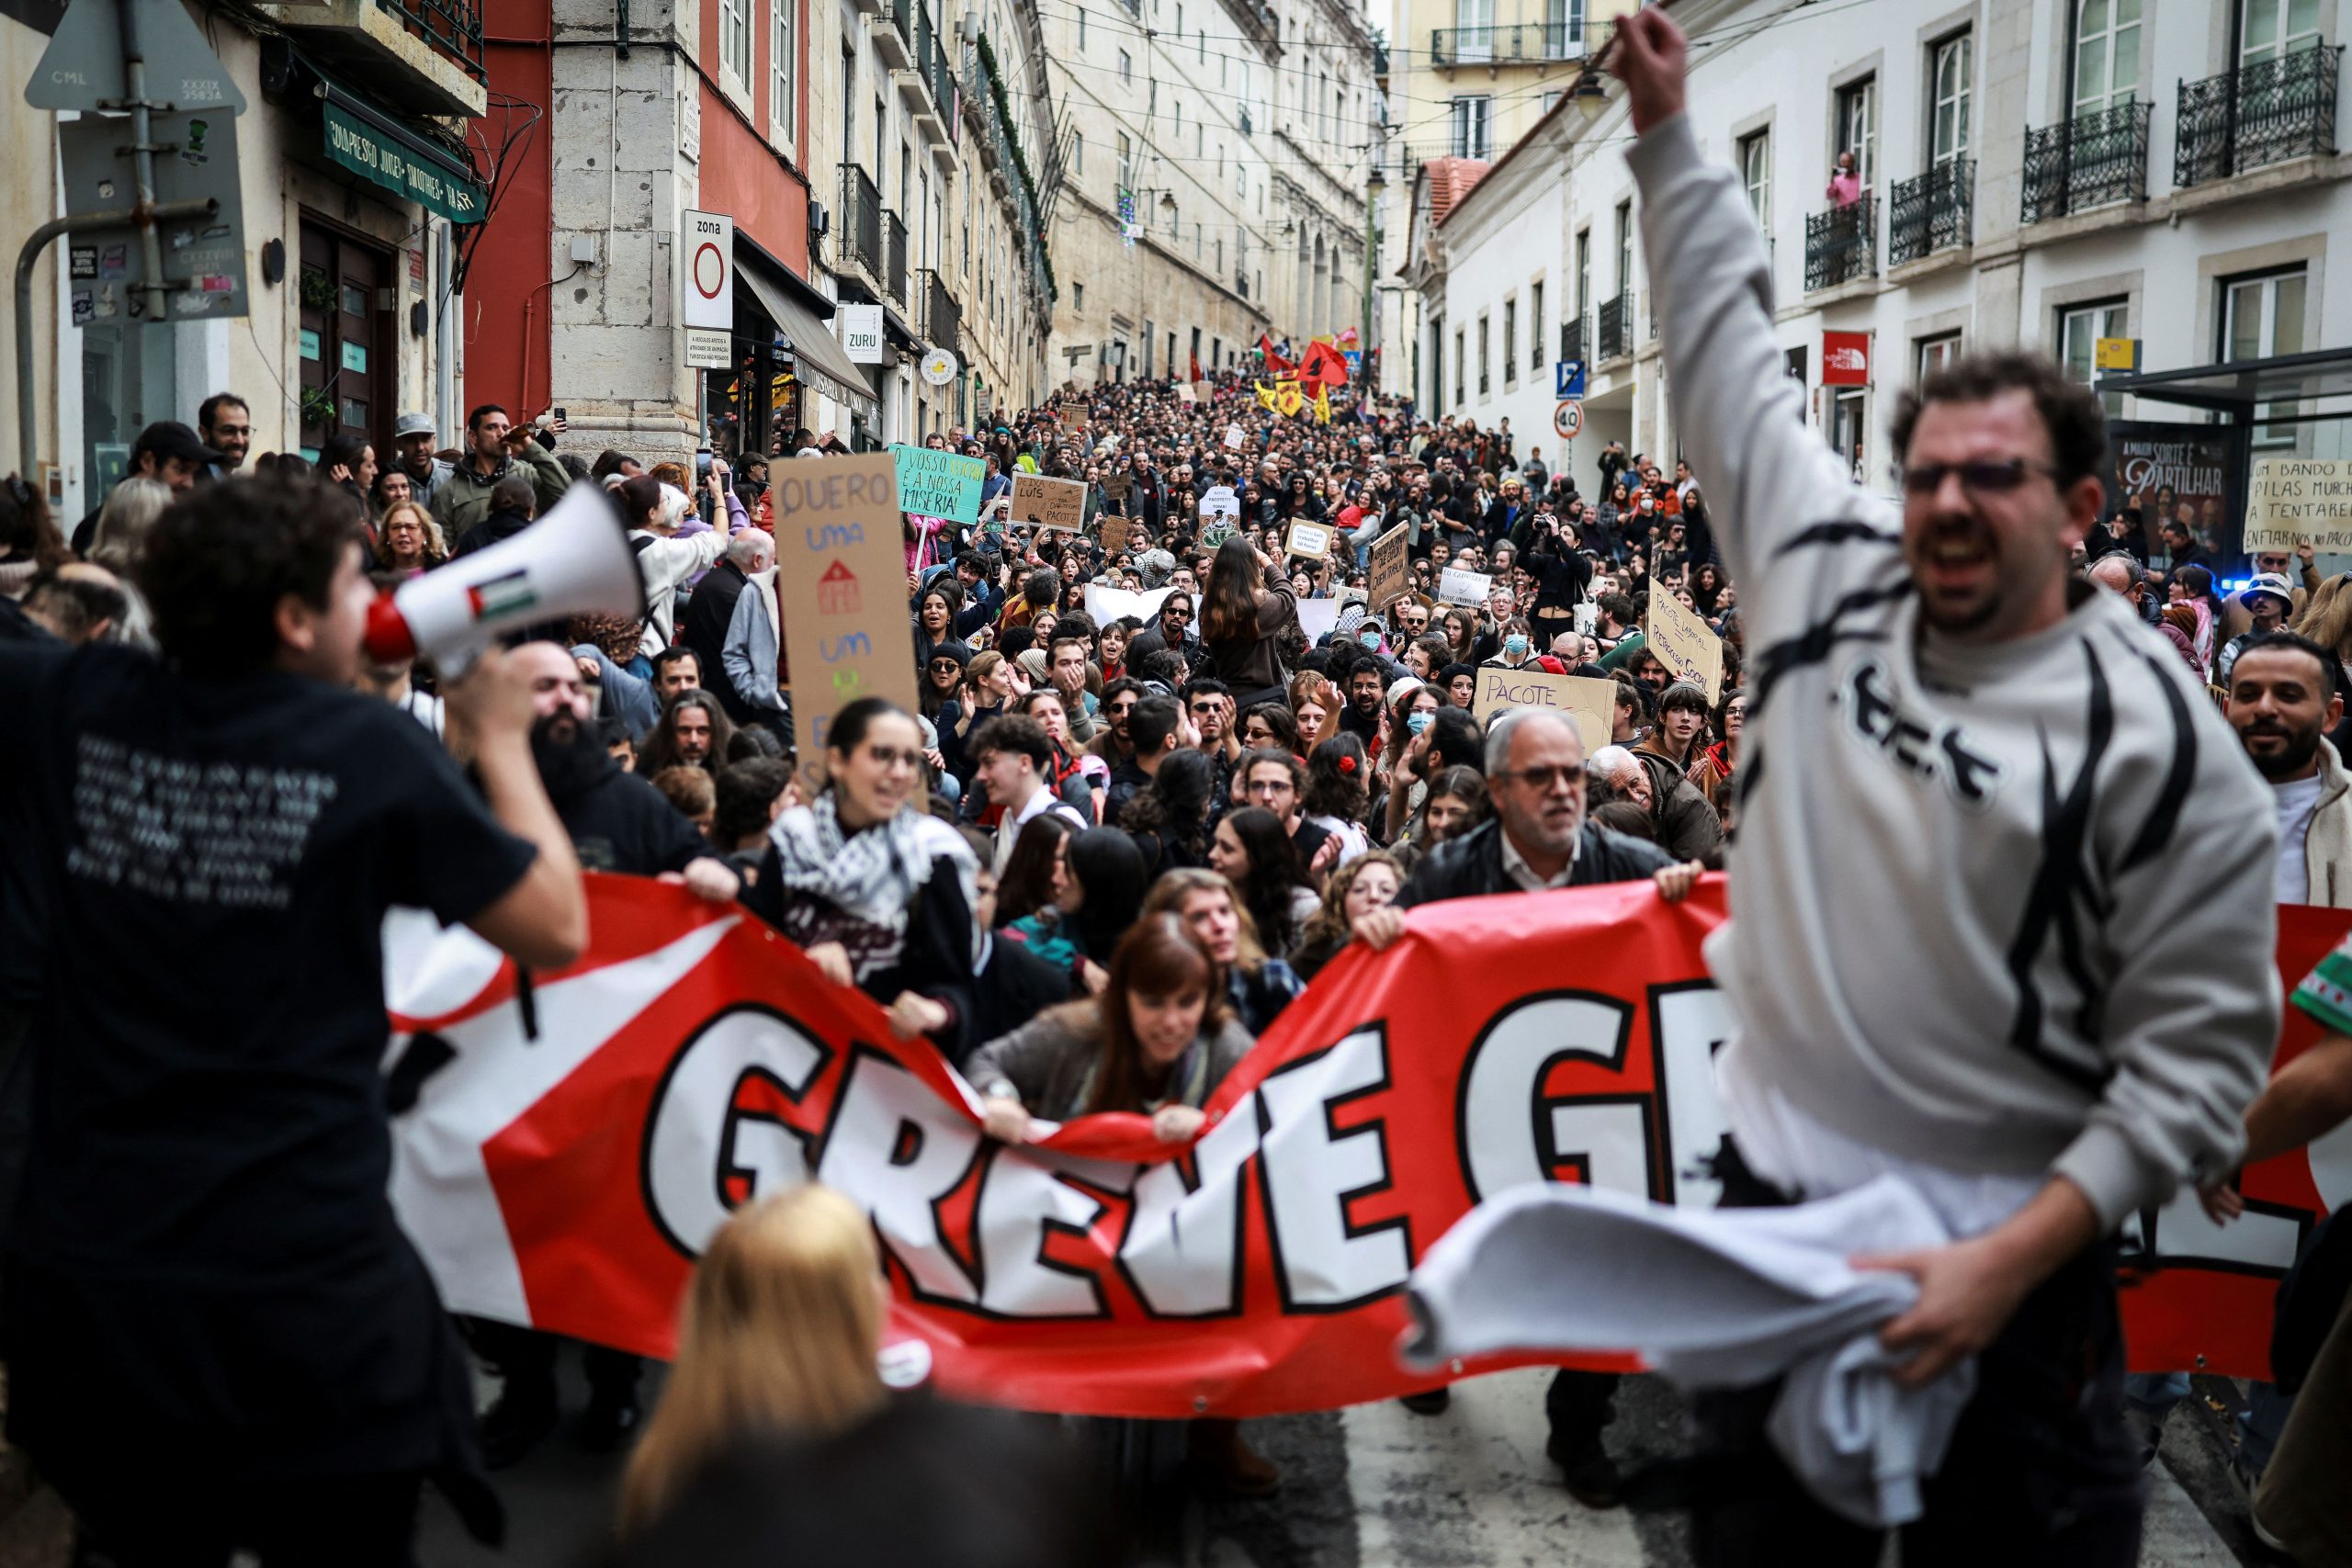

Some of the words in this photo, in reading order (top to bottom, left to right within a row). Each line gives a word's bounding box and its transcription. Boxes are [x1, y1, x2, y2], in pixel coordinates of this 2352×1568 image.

[51, 71, 87, 85] CML
[697, 220, 720, 235] zona
[849, 333, 876, 347] ZURU
[1559, 411, 1577, 426] 40
[894, 447, 901, 465] O
[910, 452, 947, 473] VOSSO
[2122, 442, 2129, 456] A
[2153, 443, 2186, 466] SORTE
[2187, 443, 2195, 467] É
[2125, 457, 2222, 495] PARTILHAR
[2256, 465, 2269, 478] UM
[2280, 463, 2335, 476] BANDO
[902, 468, 911, 487] É
[912, 471, 922, 489] A
[927, 474, 962, 496] NOSSA
[1016, 477, 1046, 488] DEIXA
[1048, 480, 1057, 490] O
[2256, 480, 2302, 497] PILAS
[781, 471, 890, 517] QUERO
[1046, 510, 1080, 525] PACOTE
[2249, 506, 2257, 522] A
[2267, 502, 2352, 518] TENTARE
[1297, 535, 1319, 544] trabalhar
[1304, 542, 1317, 550] horas
[1657, 592, 1679, 627] PACOTE
[1681, 620, 1708, 651] LABORAL
[1654, 624, 1683, 668] RETROCESSO
[1682, 658, 1709, 694] SOCIAL
[1486, 675, 1556, 705] PACOTE
[642, 1002, 1416, 1320] GREVE
